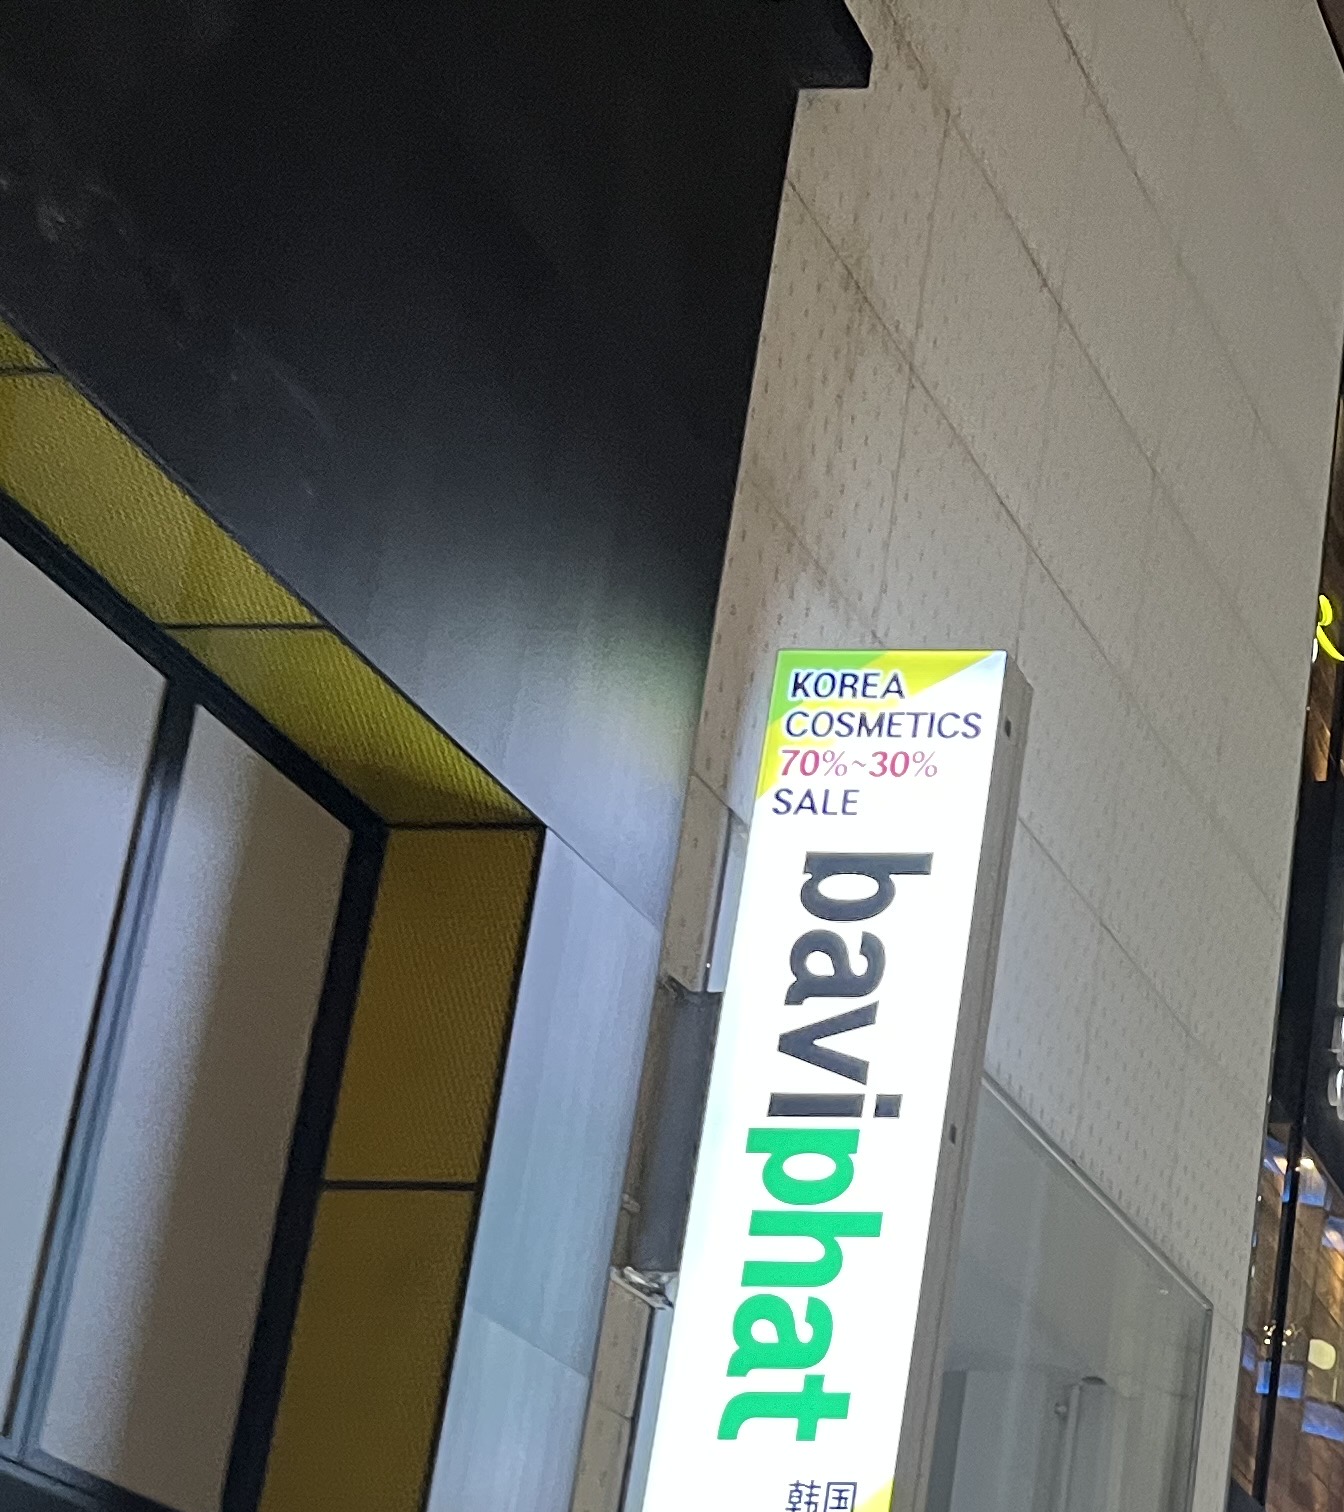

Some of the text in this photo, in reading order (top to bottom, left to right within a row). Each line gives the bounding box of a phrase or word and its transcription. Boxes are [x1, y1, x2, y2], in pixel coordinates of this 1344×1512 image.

[789, 671, 907, 700] KOREA
[784, 711, 982, 740] COSMETICS
[780, 749, 939, 778] 70%~30%
[771, 787, 861, 816] SALE
[716, 851, 935, 1442] baviphat
